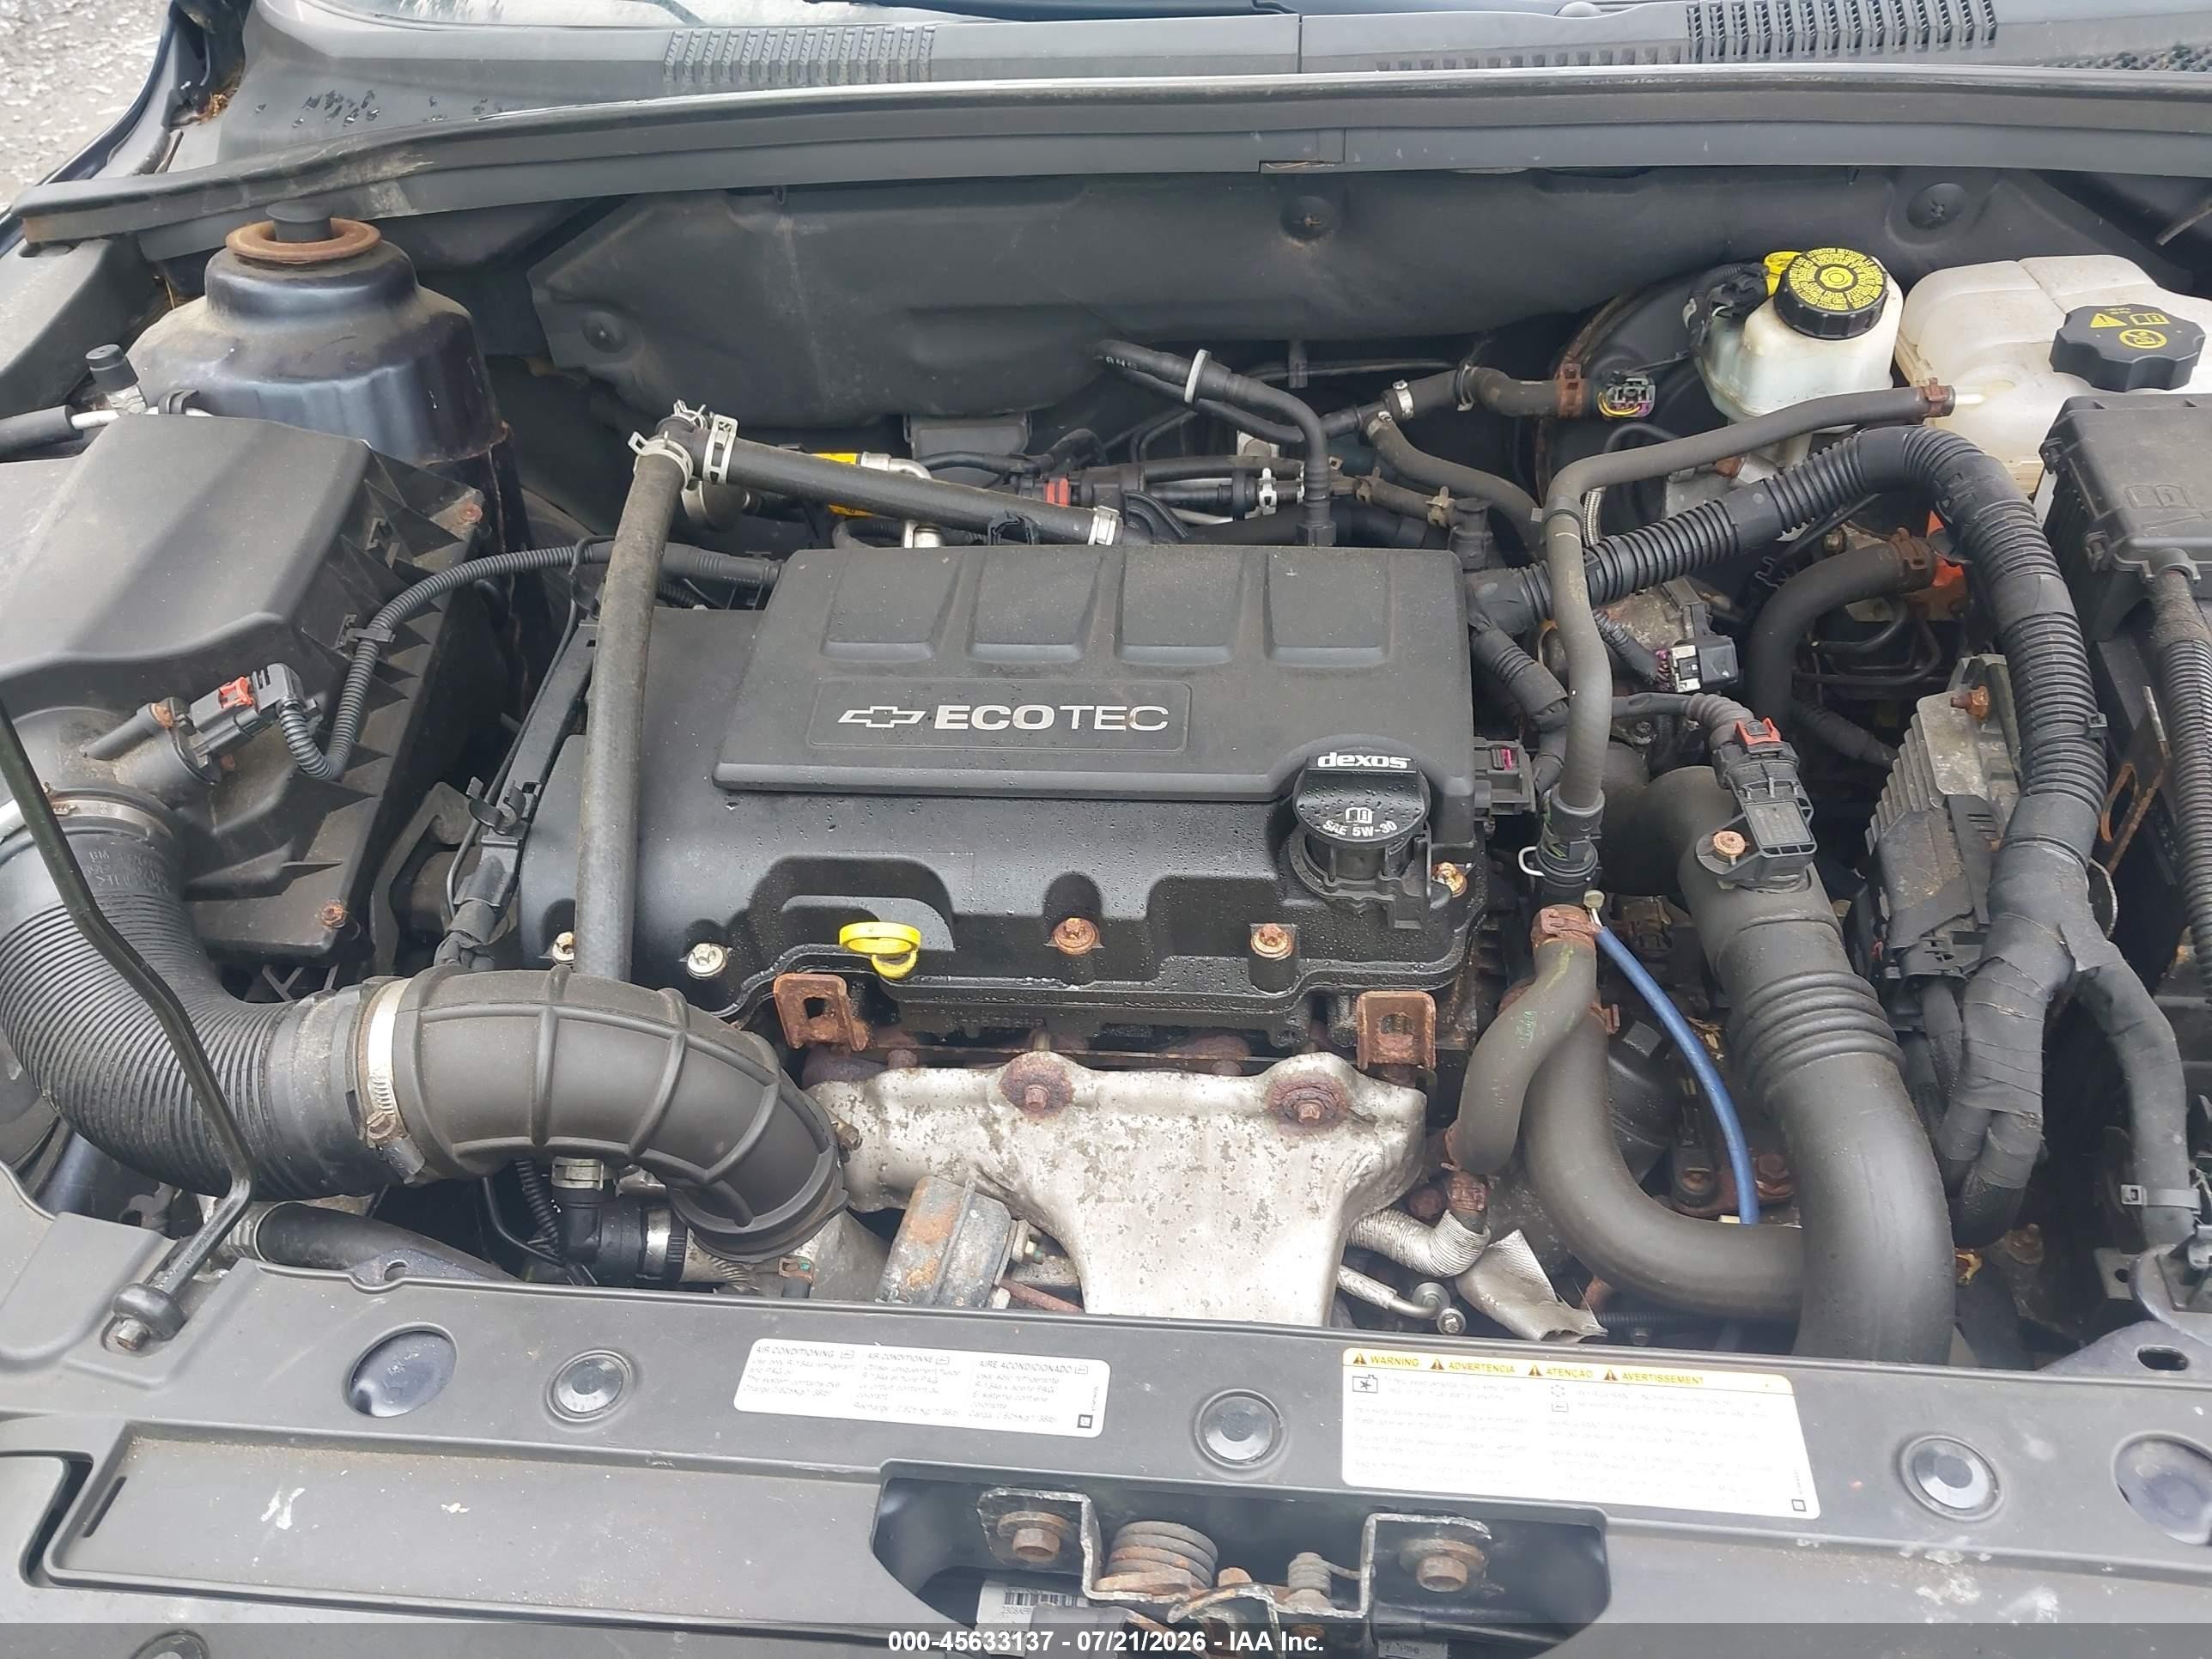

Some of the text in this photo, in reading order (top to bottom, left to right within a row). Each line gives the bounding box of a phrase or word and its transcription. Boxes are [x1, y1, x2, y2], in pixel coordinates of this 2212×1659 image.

[933, 703, 1170, 733] ECOTEC
[1317, 751, 1412, 769] dexos
[1322, 819, 1398, 837] SAE 5W-30
[756, 1346, 836, 1358] AIR CONDITIONING
[978, 1359, 1073, 1375] AIRE ACONDICIONADO
[1370, 1355, 1419, 1367] WARNING
[1449, 1362, 1516, 1374] ADVERTENCIA
[1622, 1372, 1704, 1385] AVERTISSEMENT
